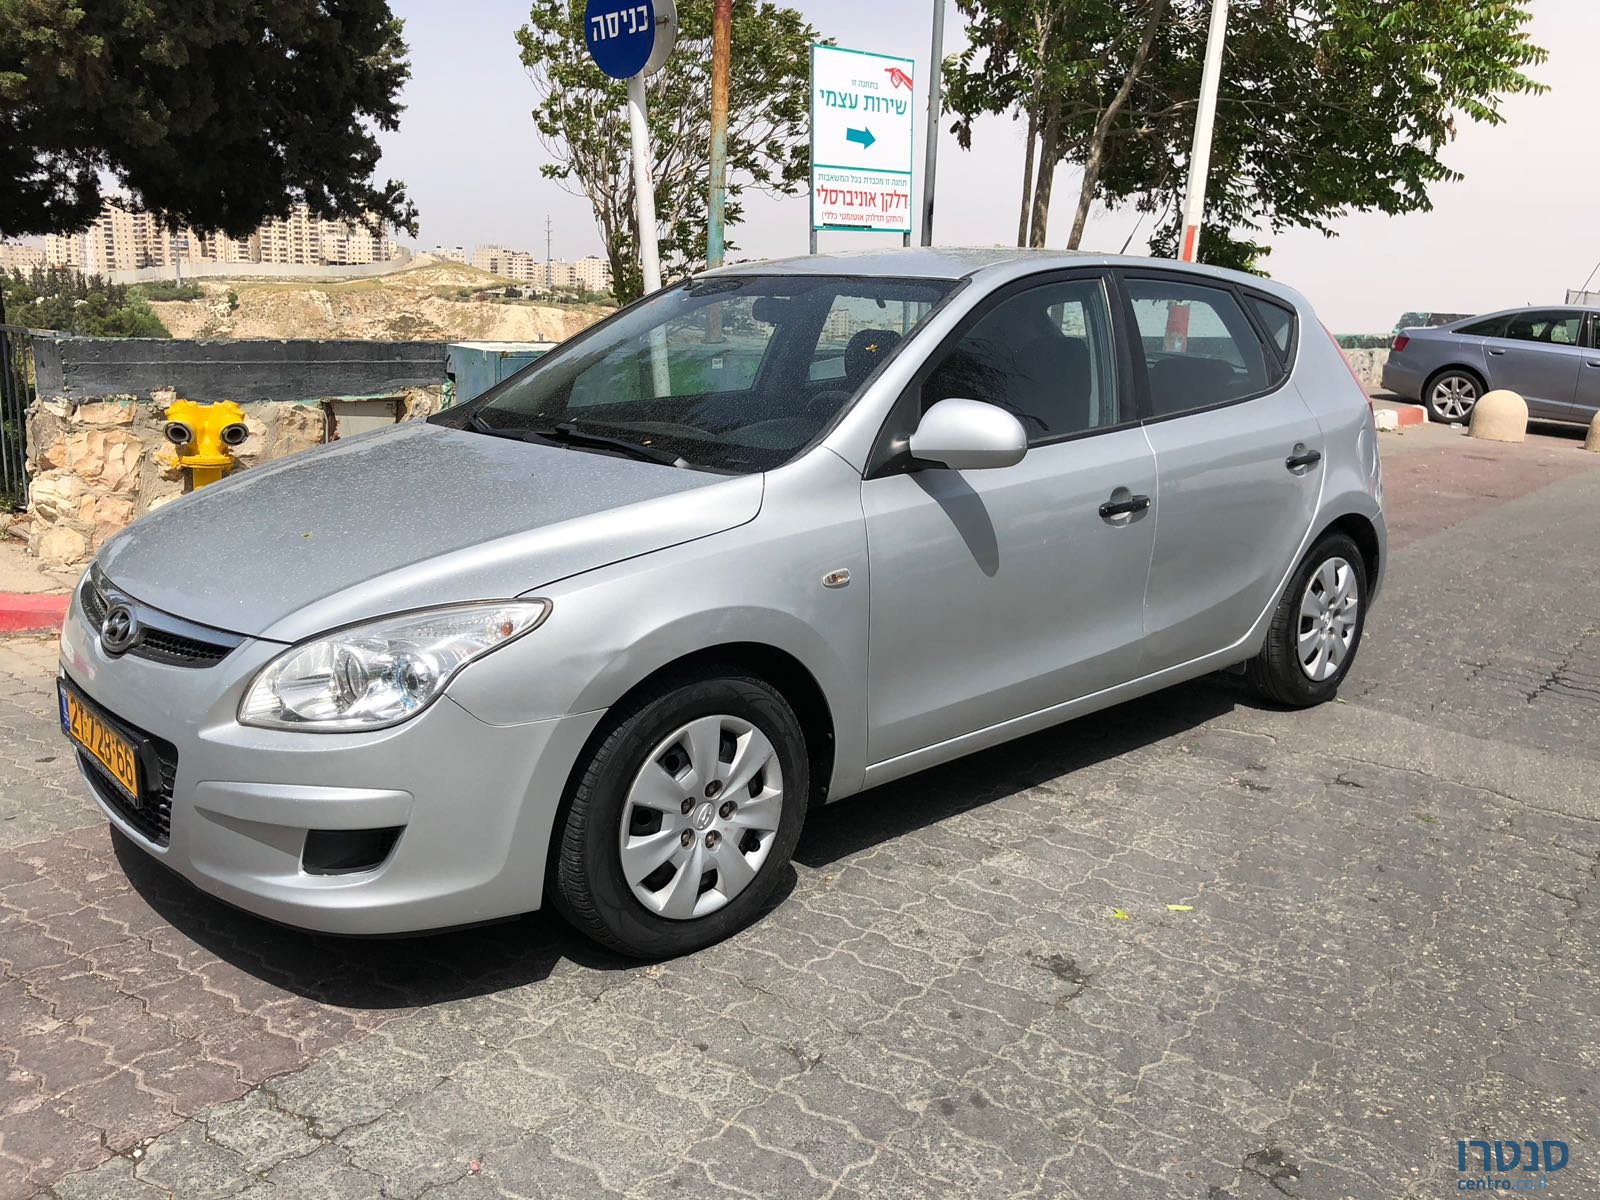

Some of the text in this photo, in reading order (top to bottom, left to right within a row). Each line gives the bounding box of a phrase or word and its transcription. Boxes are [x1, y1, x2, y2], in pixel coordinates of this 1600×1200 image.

[591, 5, 649, 42] כניסה
[851, 79, 879, 90] בתחנה זו
[819, 89, 907, 115] שירות עצמי
[818, 173, 849, 183] המשאבות
[850, 174, 862, 184] בכל
[885, 178, 890, 186] זו
[891, 179, 907, 187] תחנה
[816, 184, 909, 213] דלקן אוניברסלי
[839, 212, 864, 221] אוטומטי
